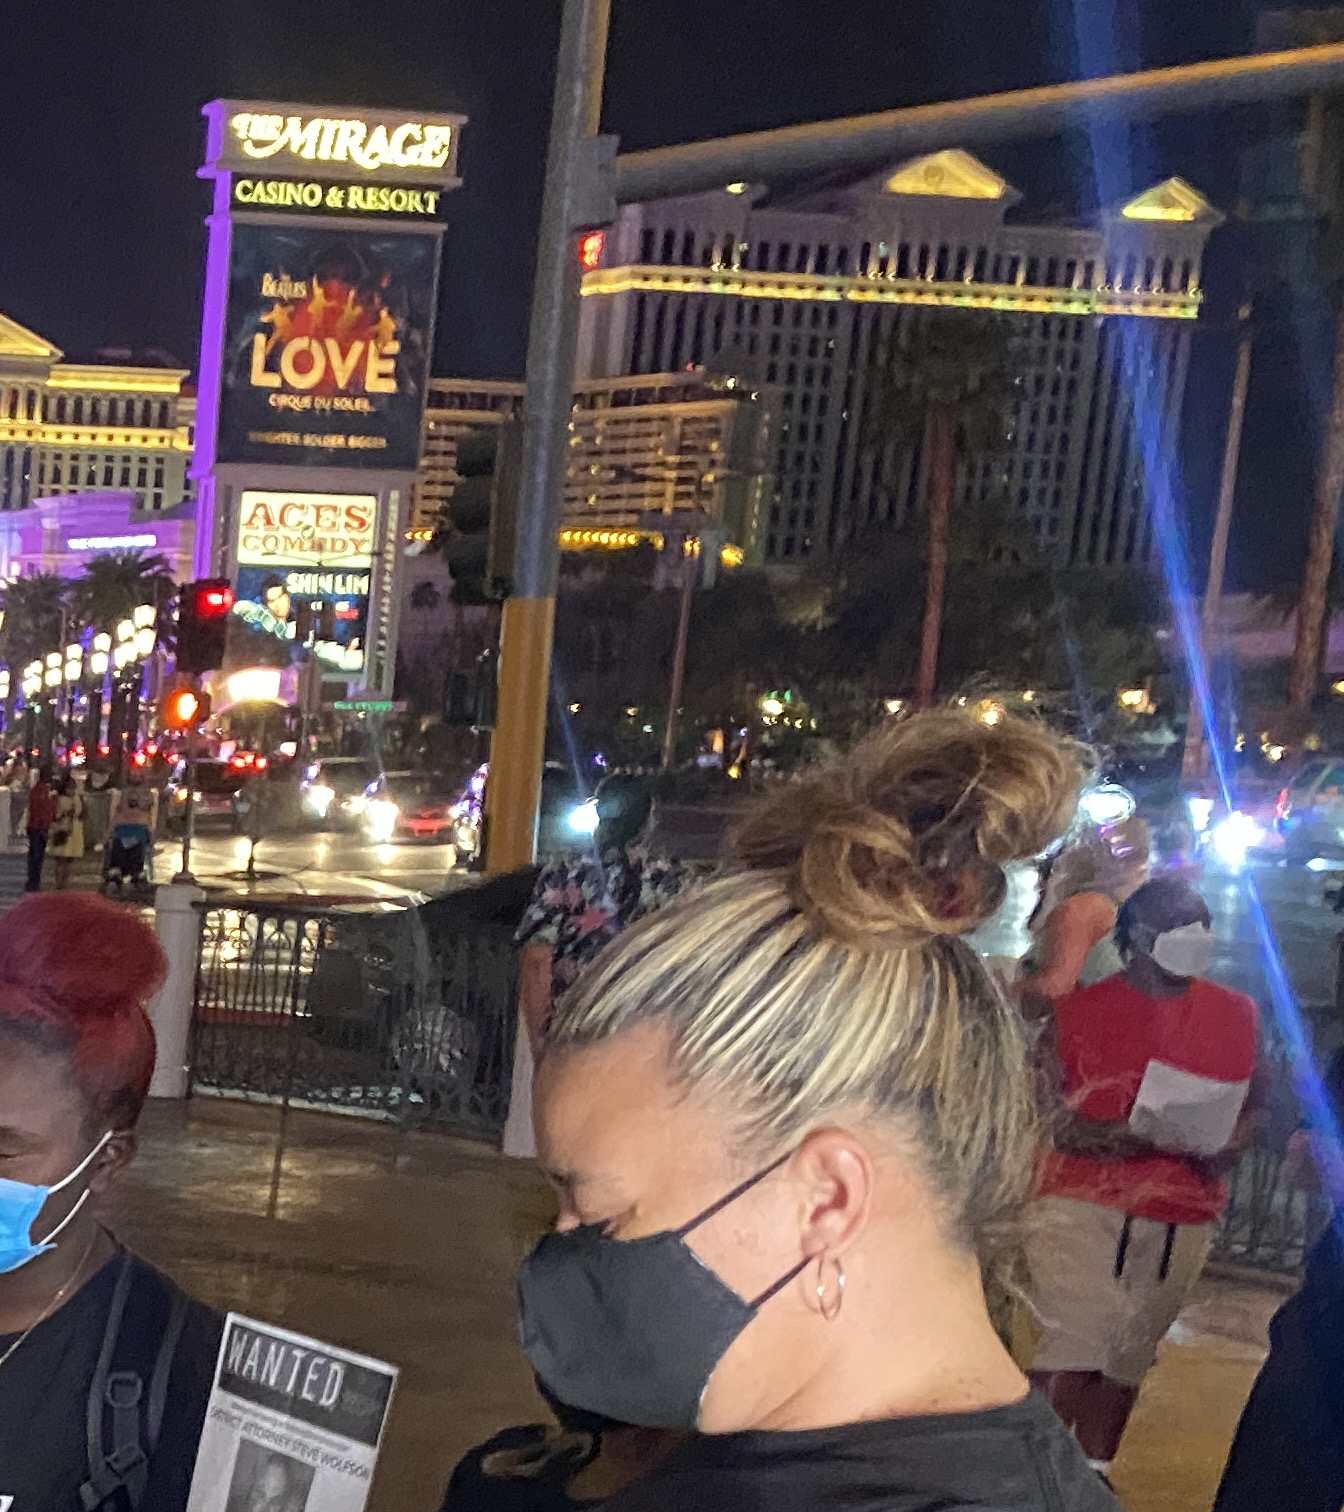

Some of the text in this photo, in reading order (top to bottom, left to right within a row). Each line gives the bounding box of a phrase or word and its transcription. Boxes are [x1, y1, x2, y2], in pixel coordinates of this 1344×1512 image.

[242, 116, 451, 170] MIRAGE
[235, 179, 440, 214] CASINO & RESORT
[250, 332, 401, 393] LOVE
[242, 502, 373, 534] ACES
[286, 572, 370, 595] SHIN LIM
[227, 1328, 346, 1409] WANTED
